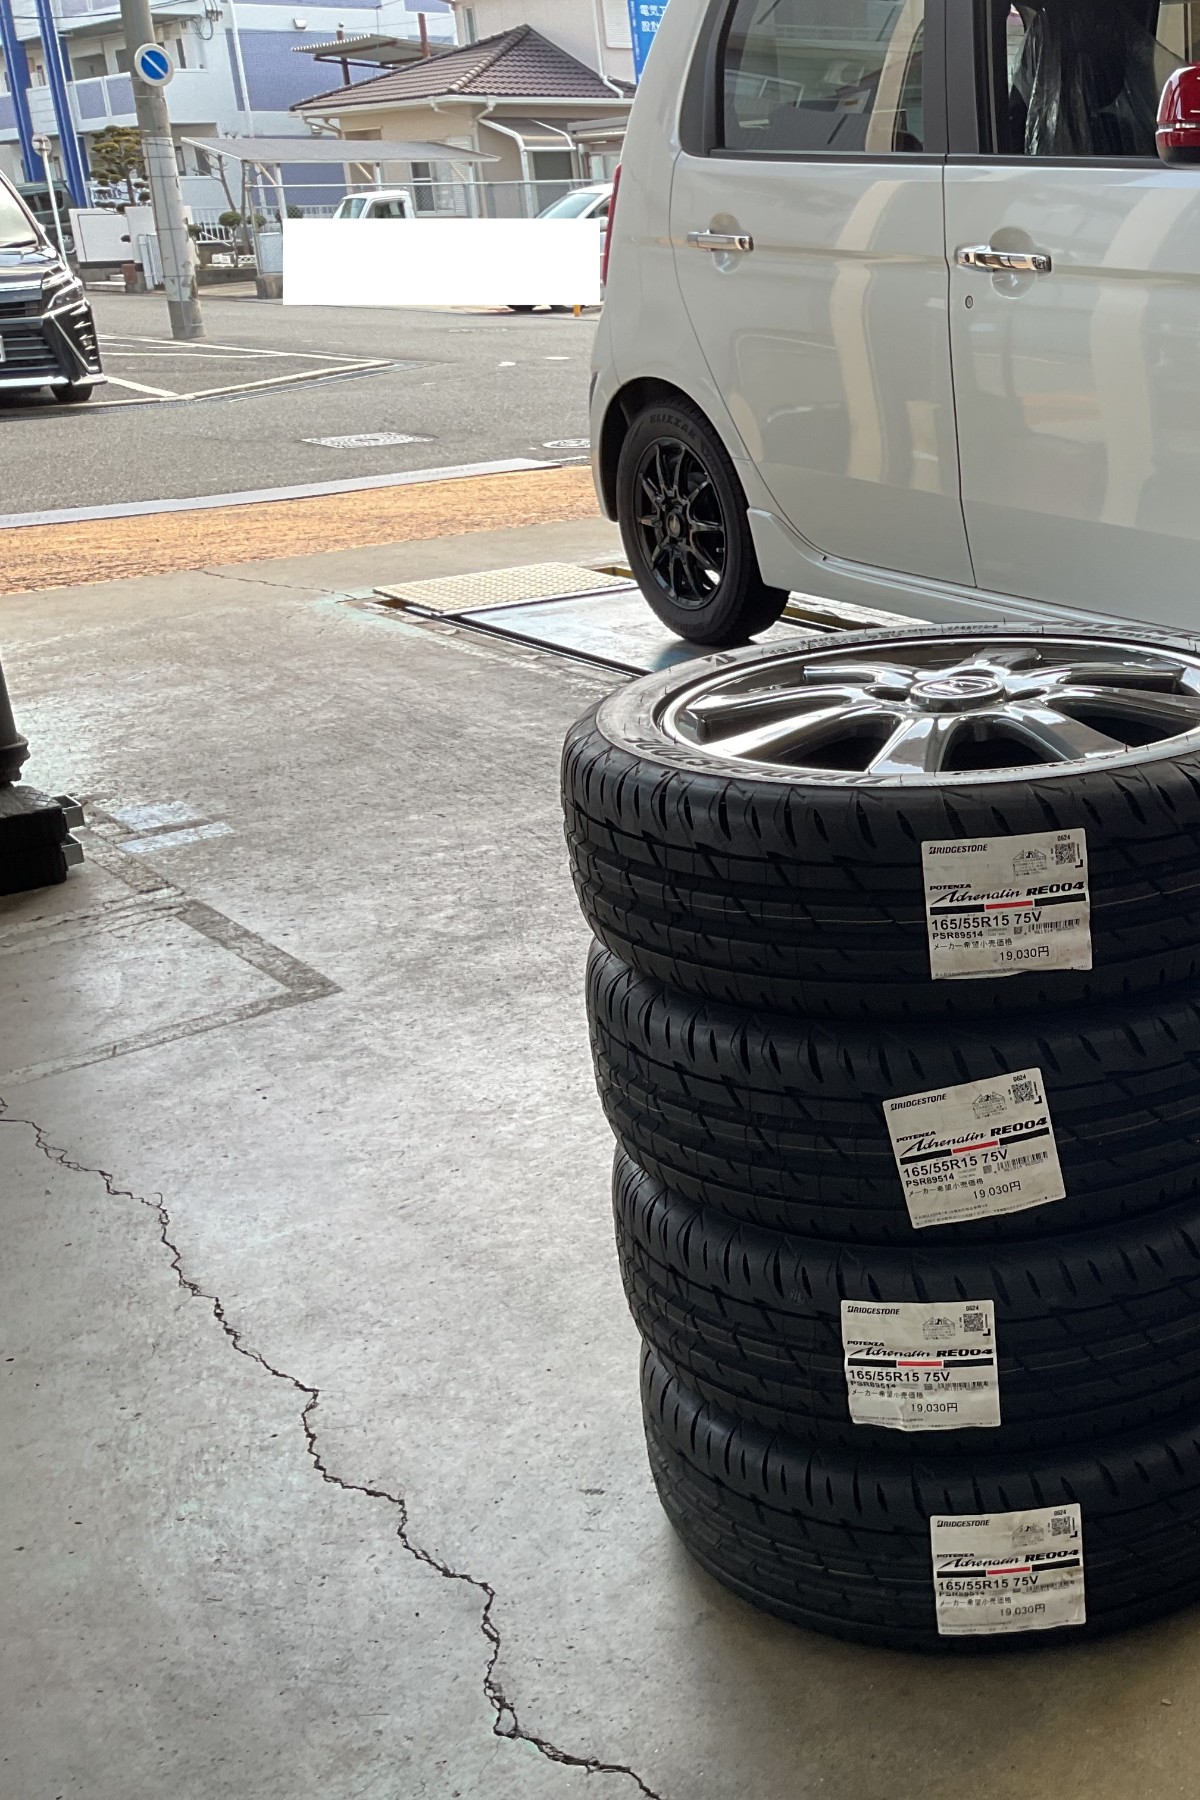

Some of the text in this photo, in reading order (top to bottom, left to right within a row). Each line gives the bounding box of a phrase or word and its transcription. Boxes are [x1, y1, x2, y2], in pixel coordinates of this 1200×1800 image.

[929, 844, 988, 854] BRIDGESTONE
[931, 881, 1084, 905] Adrenalin RE004
[932, 910, 1042, 930] 165/55R15 75V
[932, 931, 983, 940] PSR89514
[934, 939, 1013, 950] メーカー希望小売価格
[1000, 946, 1049, 962] 19,030円
[890, 1093, 947, 1111] BRIDGESTONE
[896, 1131, 936, 1143] POTENZA
[900, 1117, 1048, 1157] Adrenalin RE004
[904, 1156, 978, 1178] 165/55R15
[982, 1149, 1008, 1164] 75V
[906, 1173, 955, 1187] PSR89514
[909, 1178, 984, 1197] メーカー希望小売価格
[973, 1180, 1022, 1199] 19,030円
[847, 1306, 900, 1315] BRIDGESTONE
[850, 1346, 993, 1357] Adrenalin RE004
[850, 1370, 950, 1382] 165/55R15 75V
[911, 1403, 958, 1413] 19,030円
[937, 1519, 990, 1528] BRIDGESTONE
[938, 1549, 1079, 1569] Adrenalin RE004
[939, 1578, 1008, 1591] 165/55R15
[1013, 1576, 1039, 1587] 75V
[1000, 1603, 1045, 1616] 19,030円
